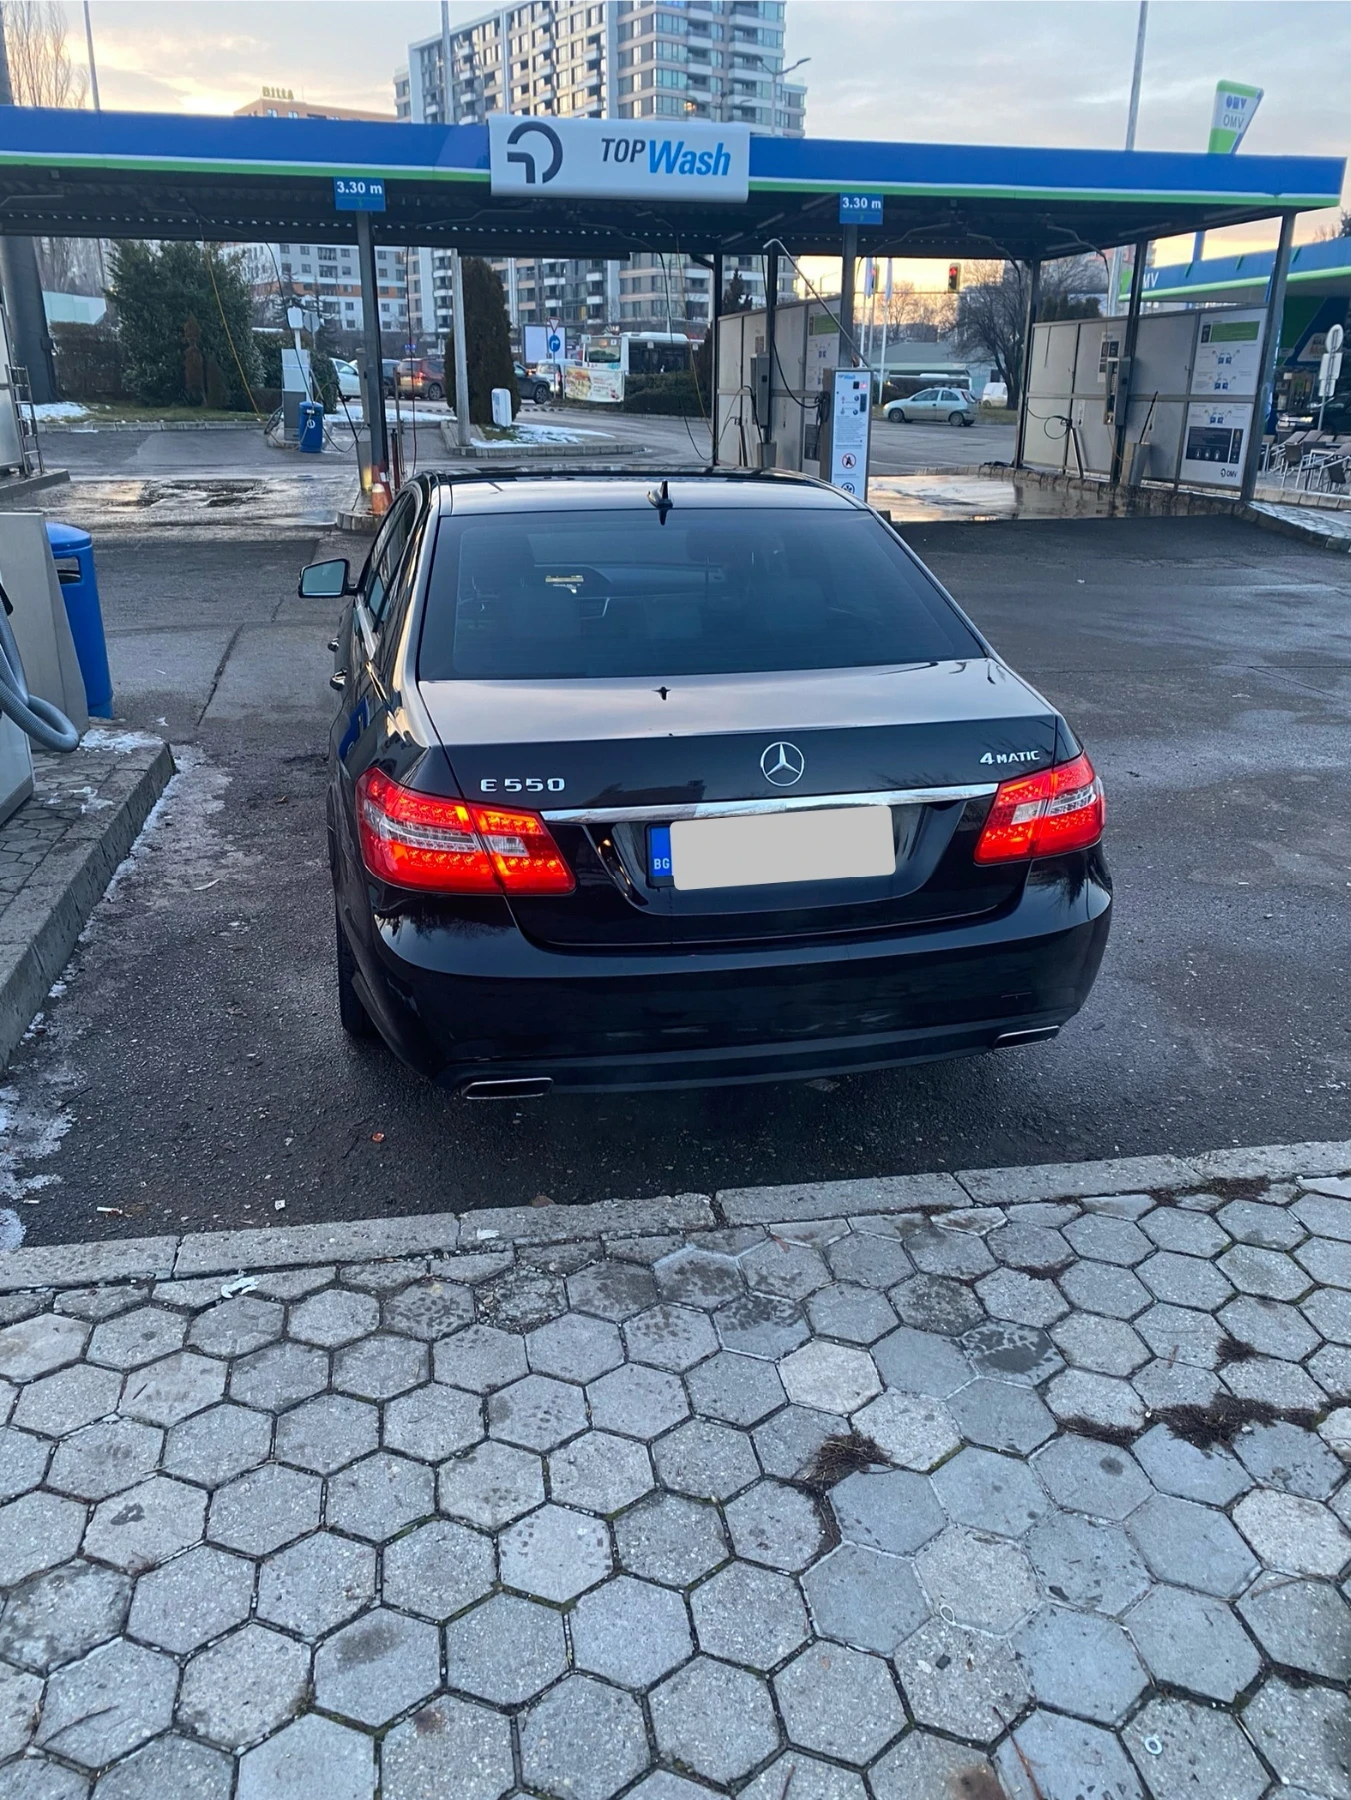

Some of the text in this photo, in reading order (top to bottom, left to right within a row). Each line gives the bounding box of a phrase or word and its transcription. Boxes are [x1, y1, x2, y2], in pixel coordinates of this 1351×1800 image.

[1223, 114, 1244, 129] OMV
[336, 181, 382, 194] 3.30 m
[842, 197, 882, 209] 3.30 m
[653, 857, 670, 870] BG
